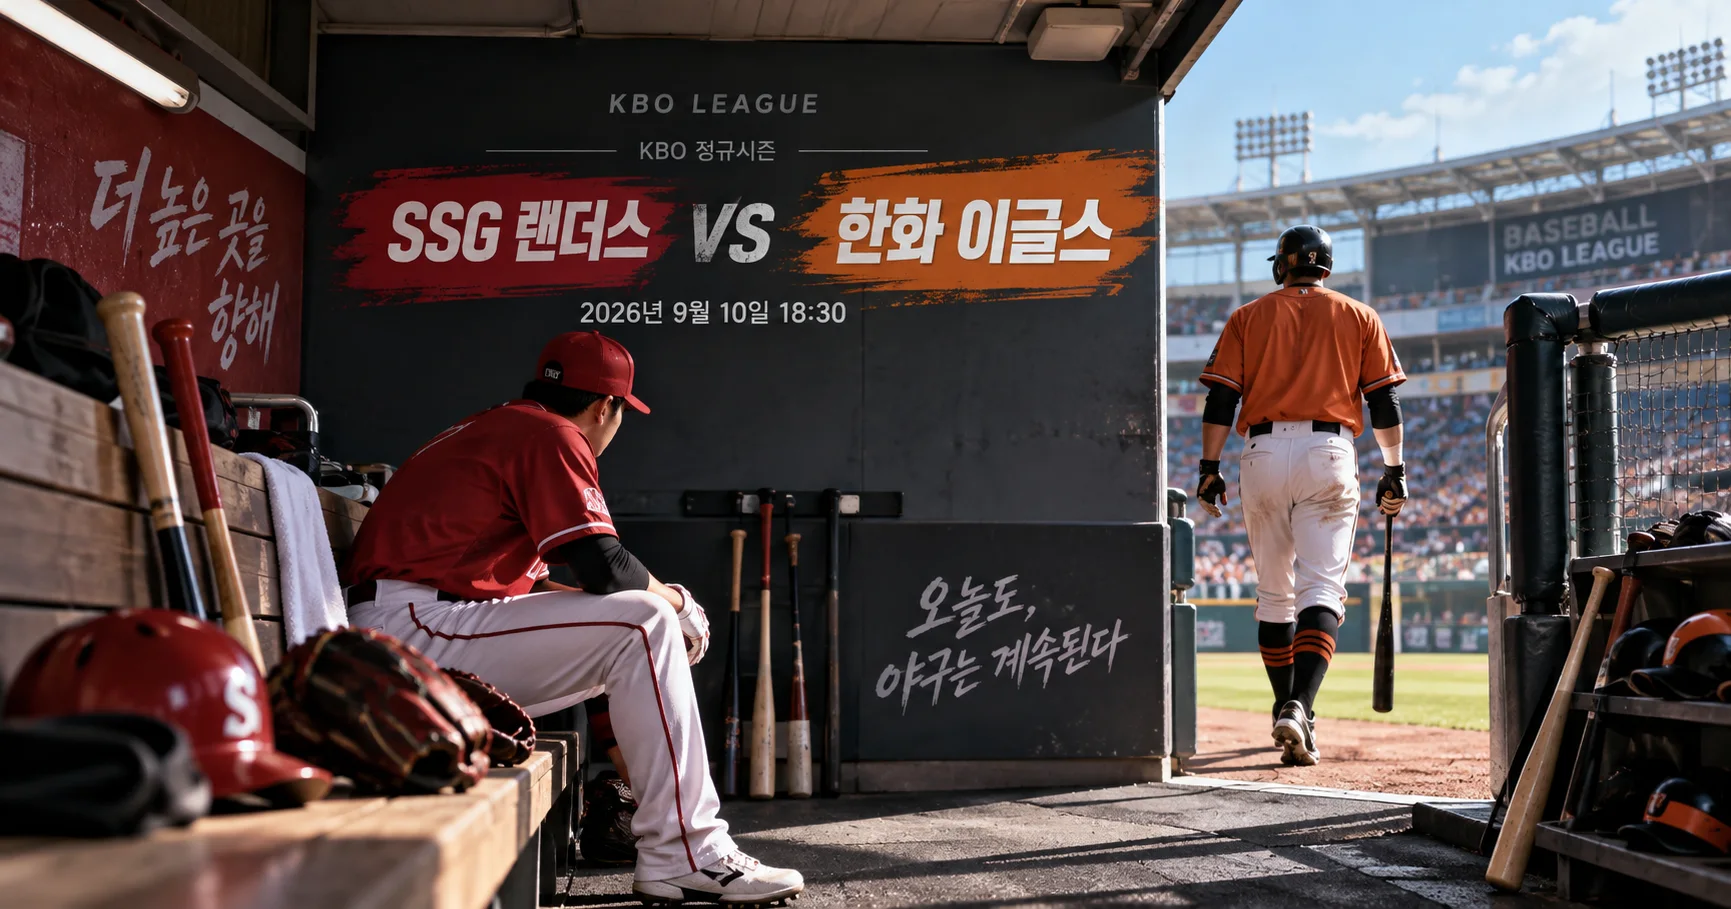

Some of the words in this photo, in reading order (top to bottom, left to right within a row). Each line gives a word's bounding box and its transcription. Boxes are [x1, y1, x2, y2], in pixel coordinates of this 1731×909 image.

[609, 93, 674, 114] KBO
[692, 93, 818, 114] LEAGUE
[639, 141, 687, 160] KBO
[695, 140, 776, 162] 정규시즌
[90, 146, 151, 268] 더
[149, 166, 213, 268] 높은
[215, 189, 269, 277] 곳을
[387, 200, 503, 263] SSG
[515, 199, 651, 262] 랜더스
[692, 198, 776, 264] VS
[836, 197, 945, 265] 한화
[957, 198, 1113, 264] 이글스
[1503, 204, 1658, 249] BASEBALL
[1504, 249, 1554, 275] KBO
[1561, 232, 1660, 268] LEAGUE
[208, 278, 280, 371] 향해
[580, 300, 663, 325] 2026년
[673, 300, 710, 325] 9월
[720, 300, 769, 325] 10일
[779, 301, 846, 324] 18:30
[905, 574, 1036, 640] 오늘도,
[875, 648, 983, 716] 야구는
[991, 618, 1131, 690] 계속된다
[223, 671, 262, 739] S
